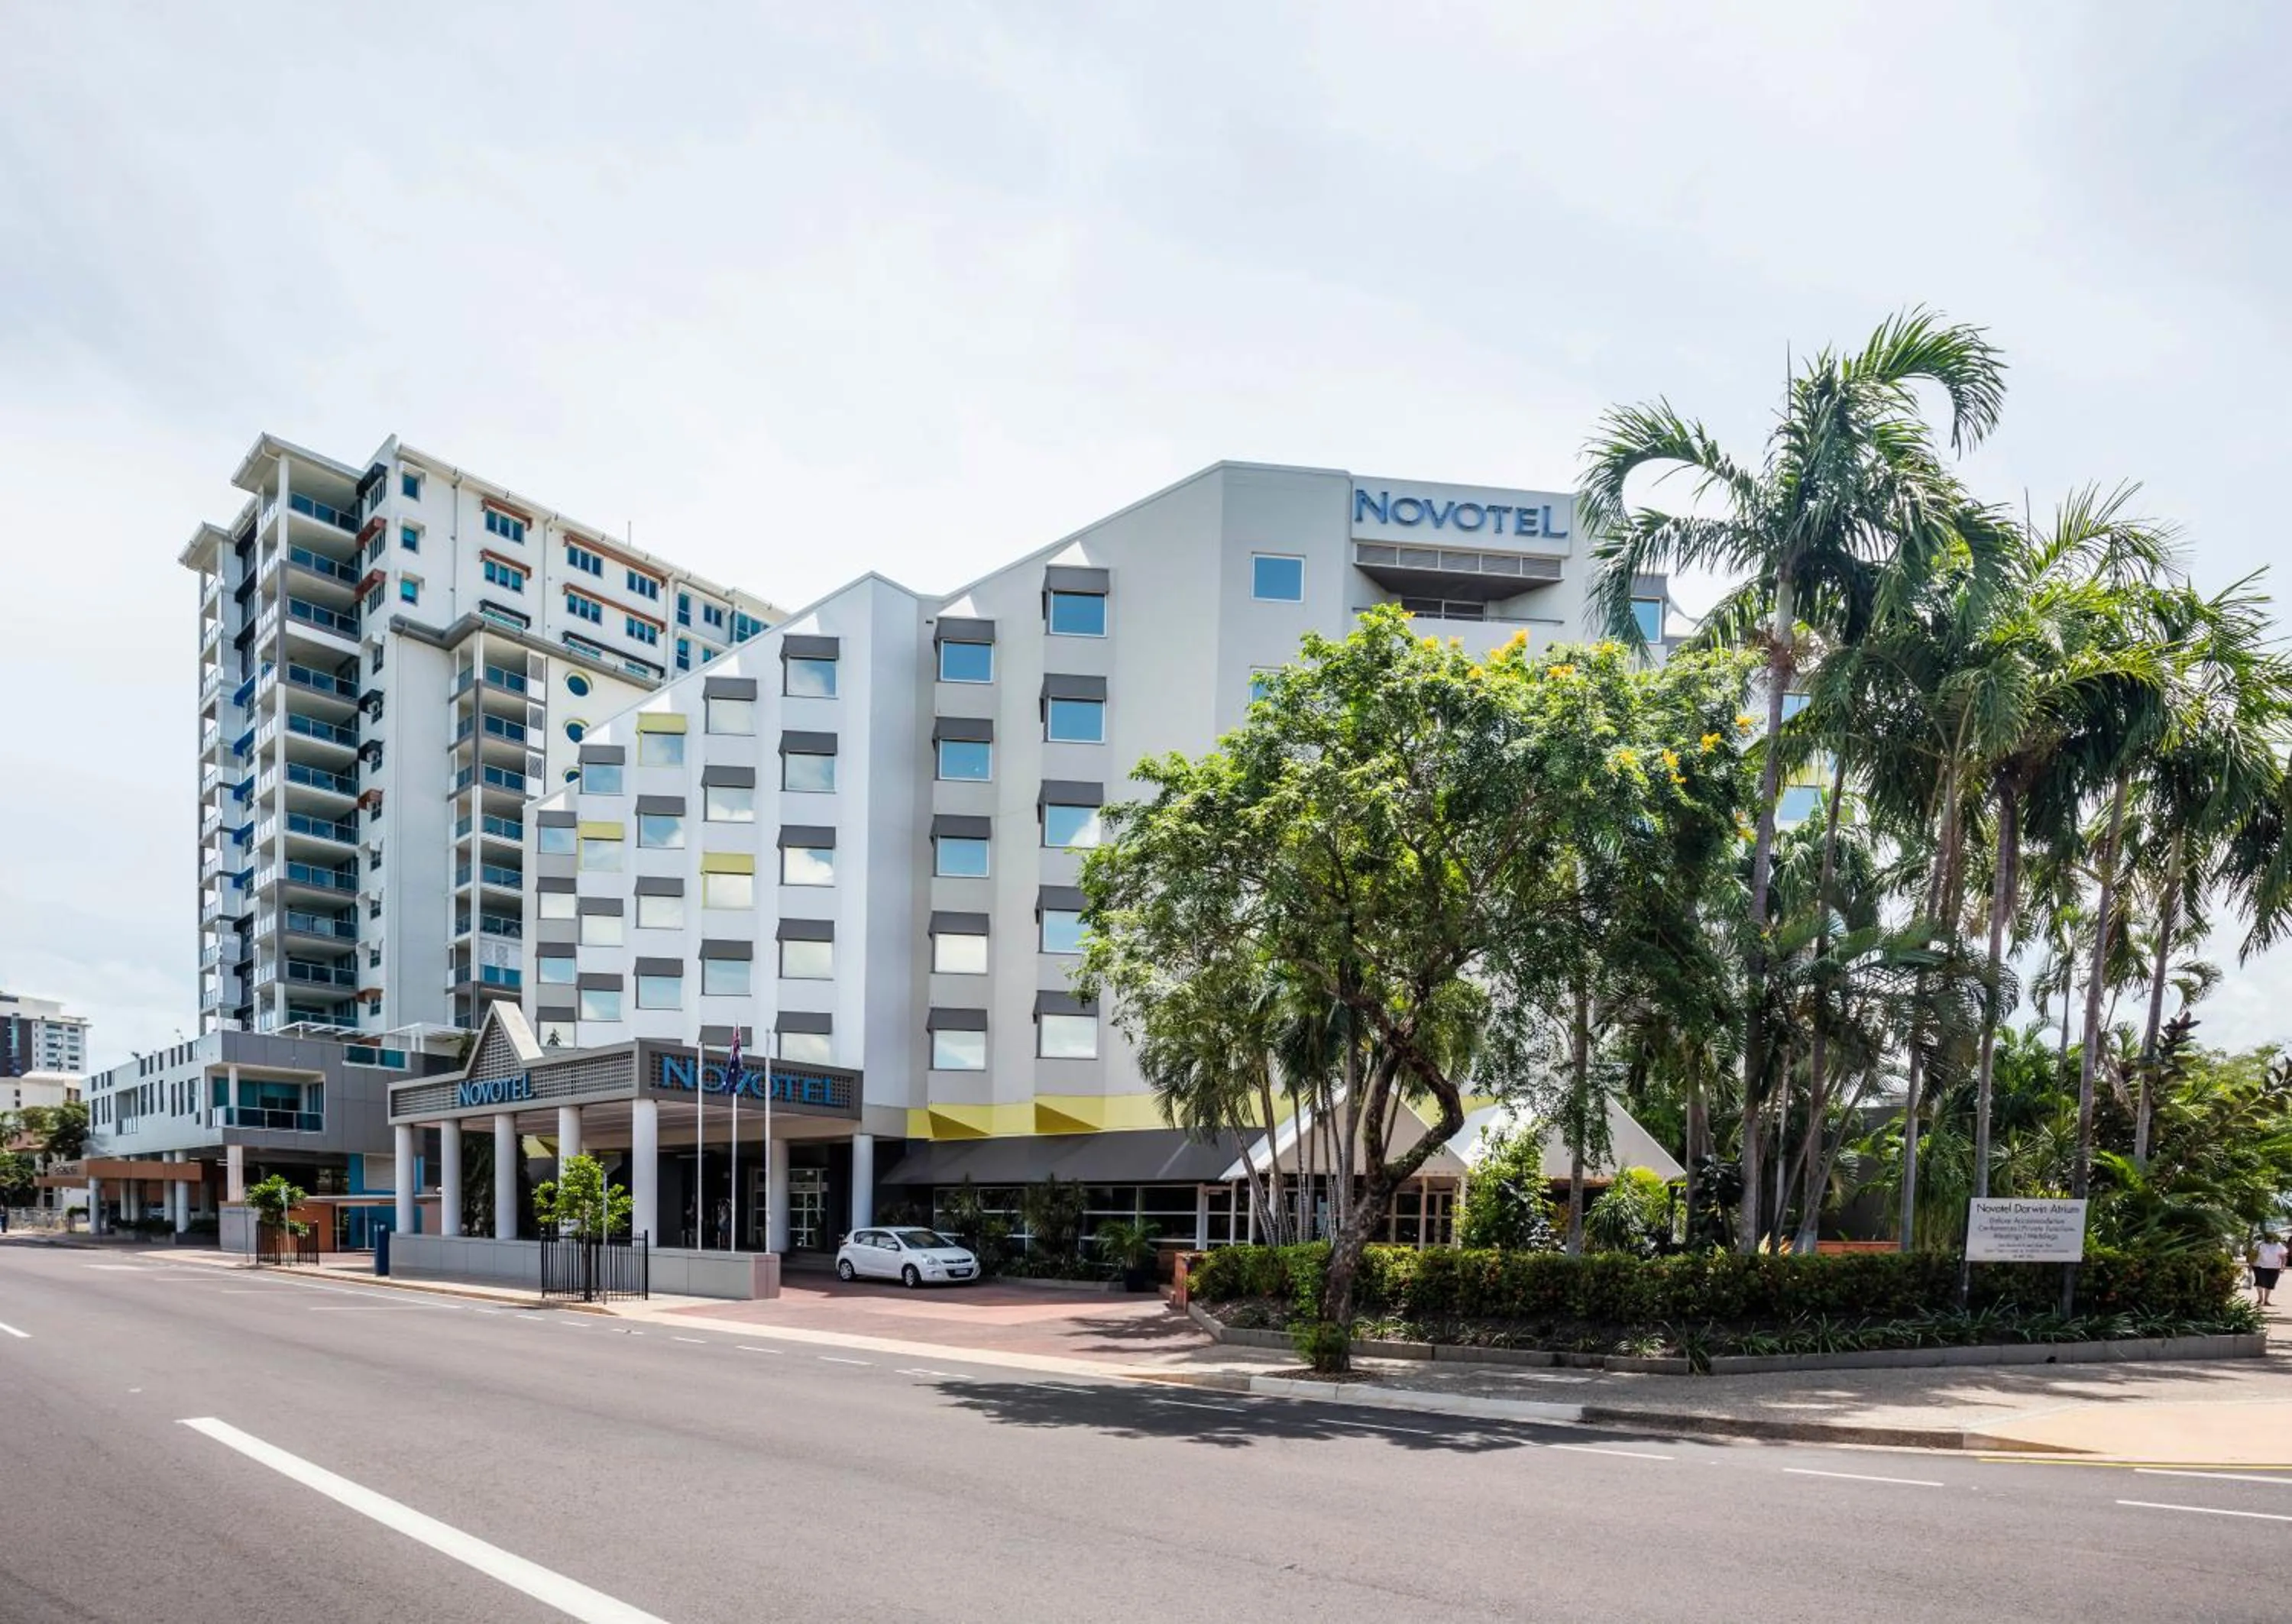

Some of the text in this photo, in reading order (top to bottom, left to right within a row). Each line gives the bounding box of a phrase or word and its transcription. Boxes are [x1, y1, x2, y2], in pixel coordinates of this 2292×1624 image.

[1355, 489, 1568, 539] NOVOTEL
[457, 1071, 535, 1107] NOVOTEL
[1976, 1202, 2080, 1214] Novotel Darwin Atrium
